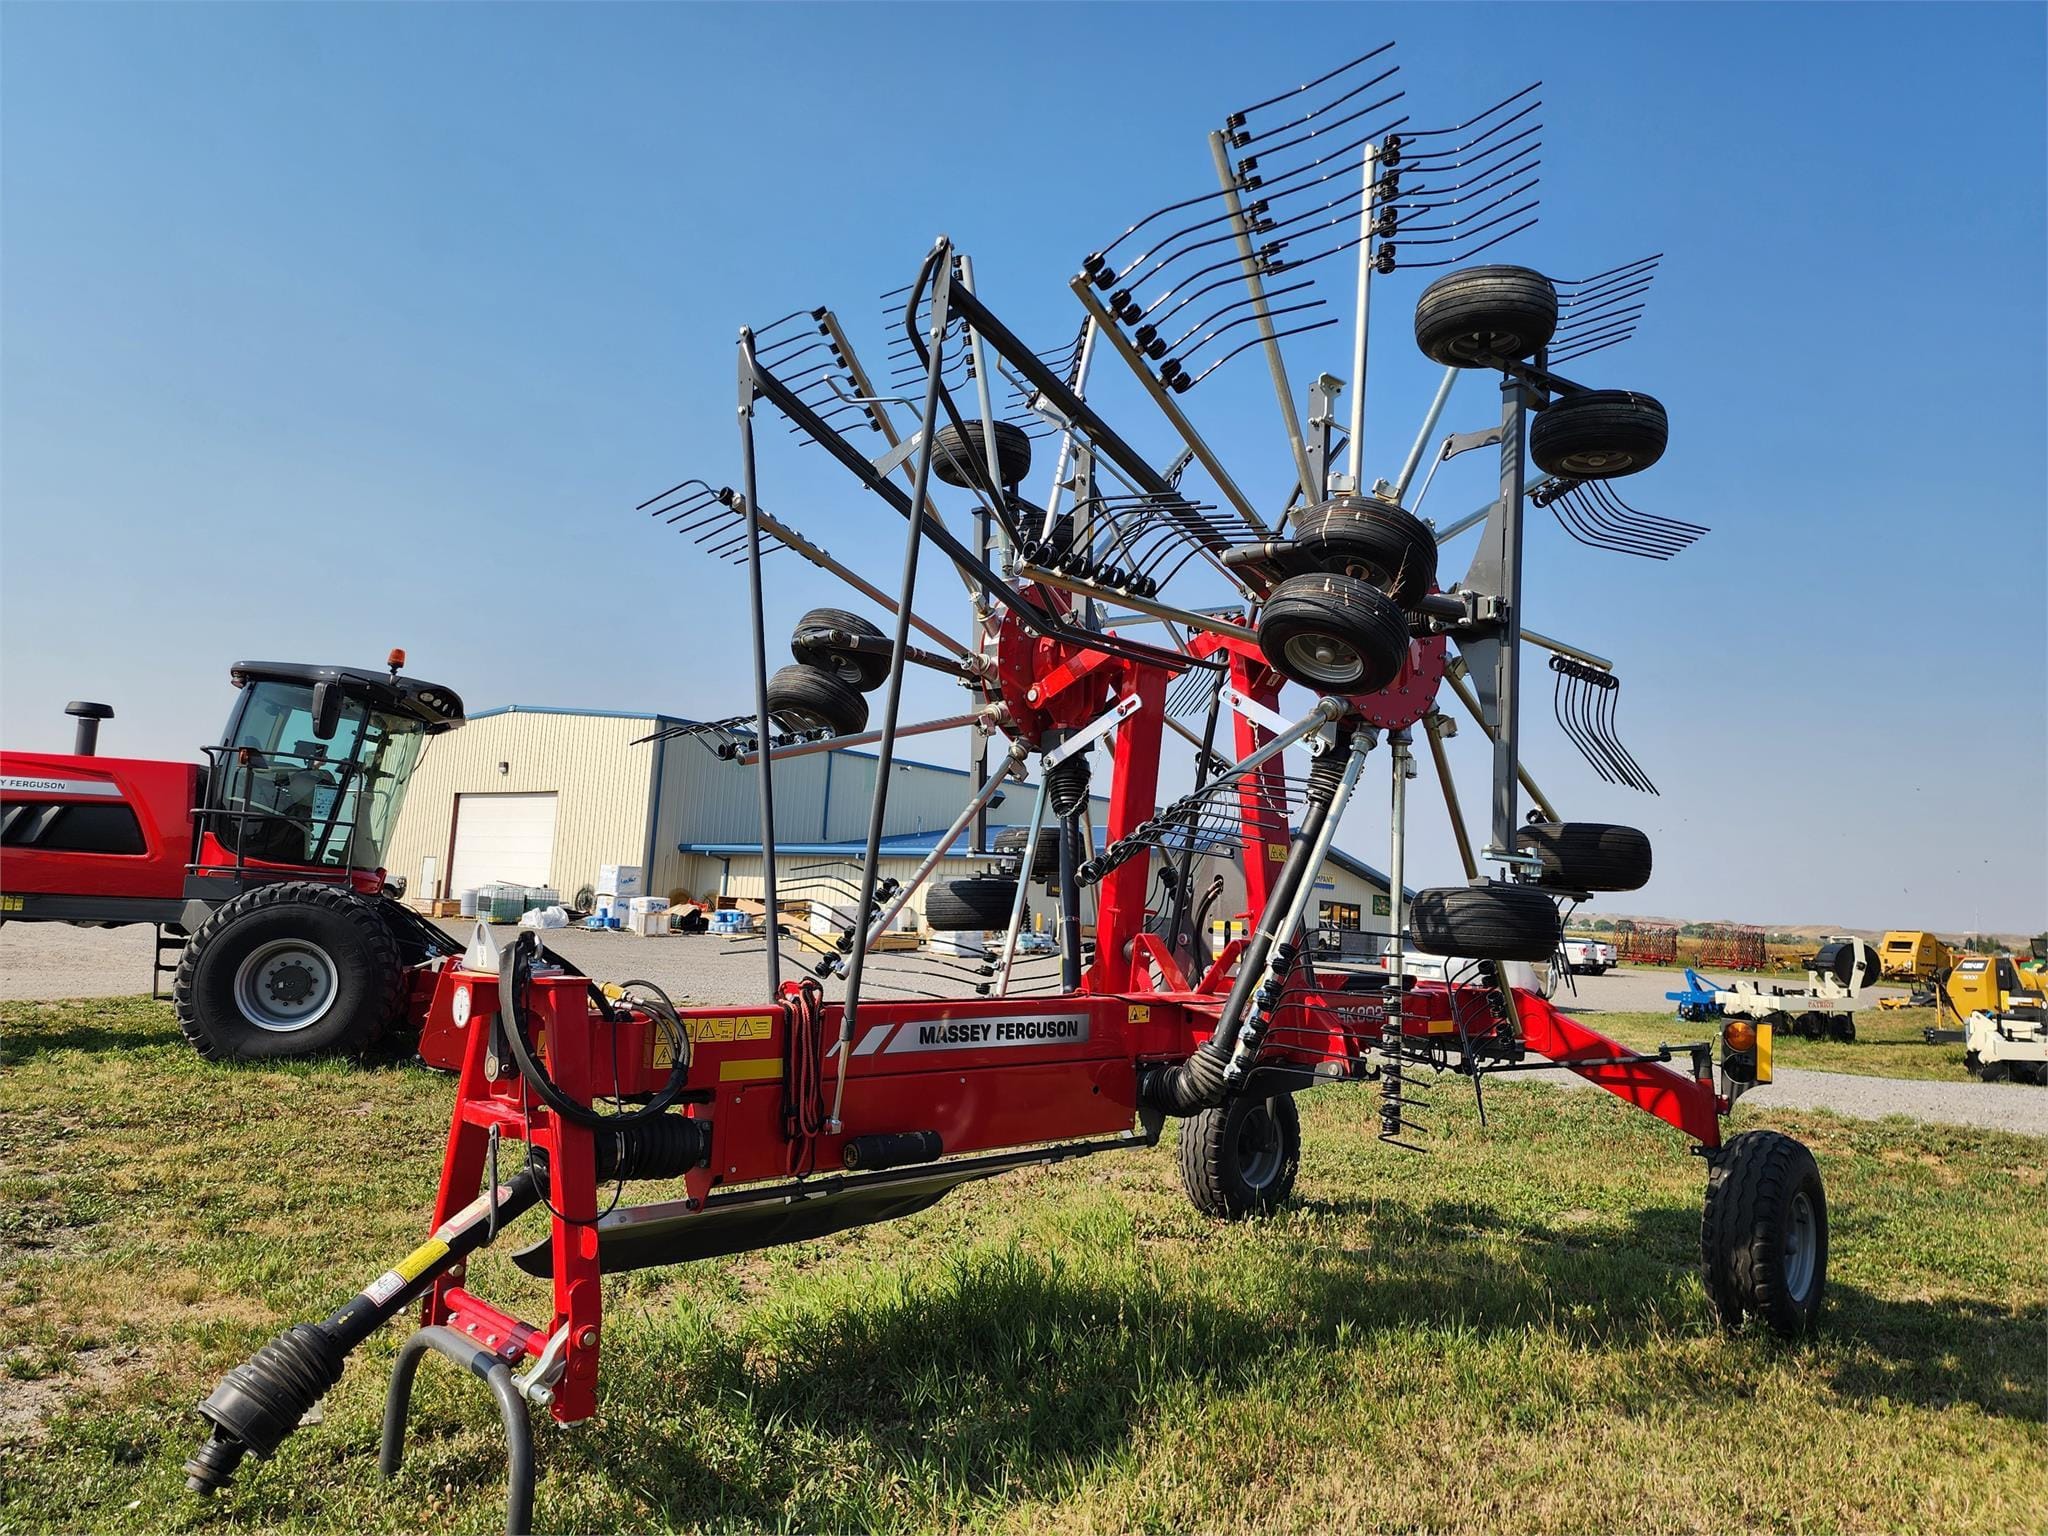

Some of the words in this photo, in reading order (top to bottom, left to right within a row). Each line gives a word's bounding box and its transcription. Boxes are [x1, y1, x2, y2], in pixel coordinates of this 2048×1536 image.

[10, 780, 66, 789] FERGUSON
[1808, 1001, 1834, 1009] PATRIOT
[919, 1024, 991, 1044] MASSEY
[996, 1020, 1078, 1040] FERGUSON
